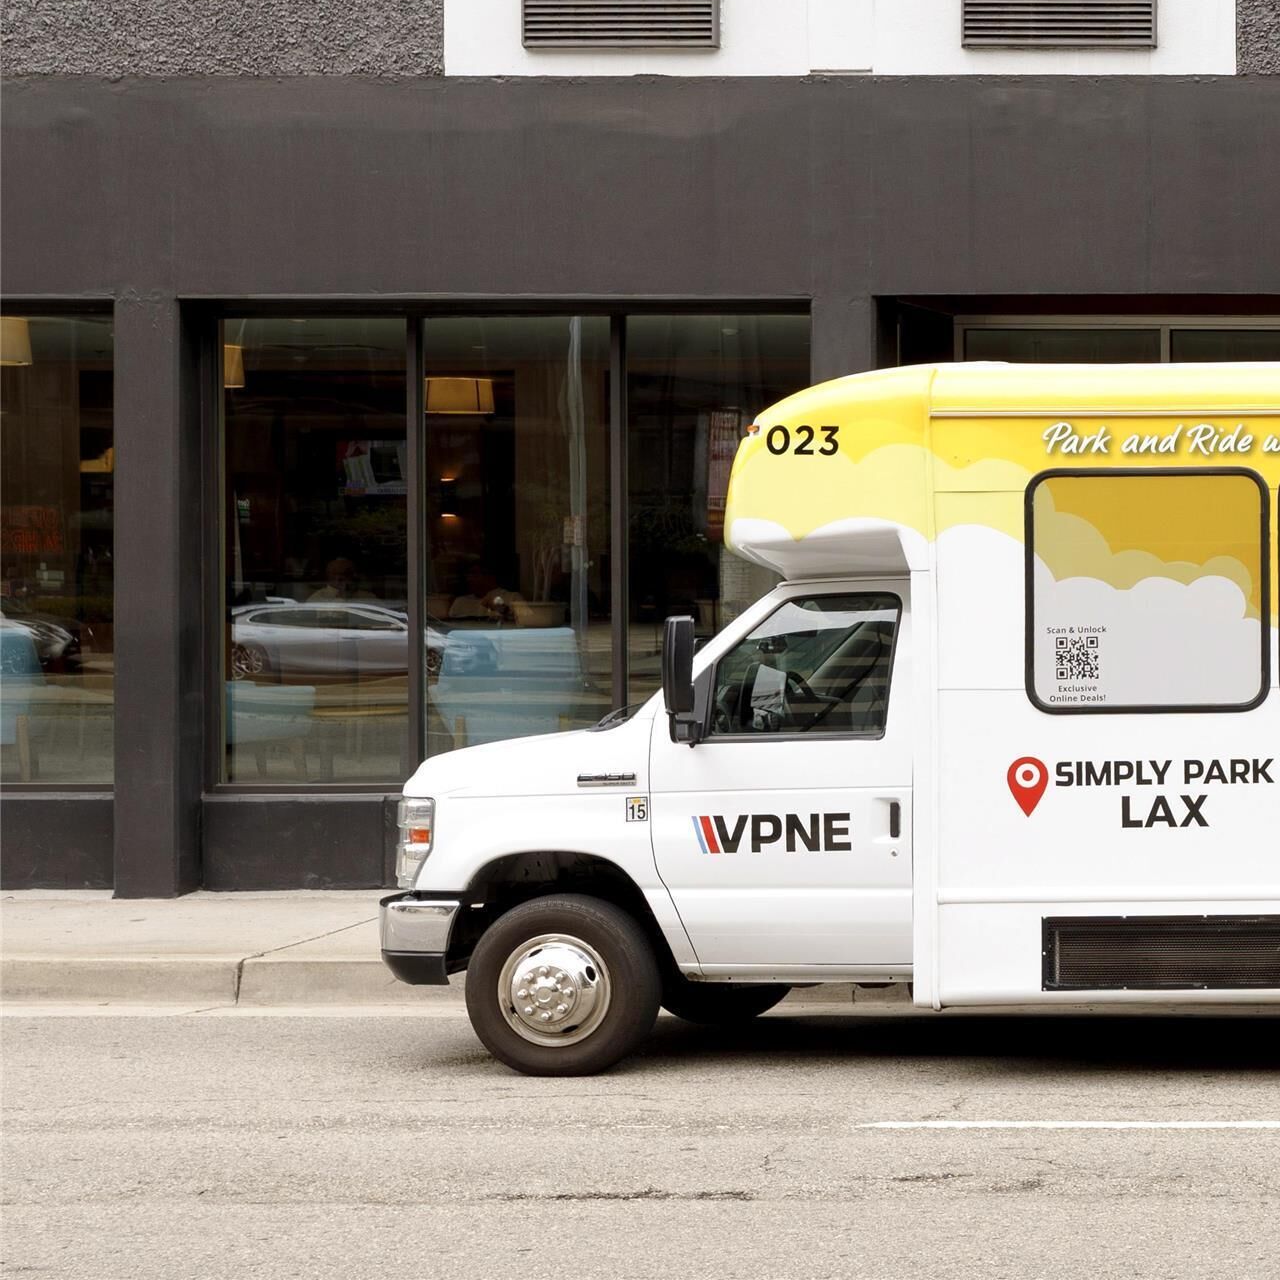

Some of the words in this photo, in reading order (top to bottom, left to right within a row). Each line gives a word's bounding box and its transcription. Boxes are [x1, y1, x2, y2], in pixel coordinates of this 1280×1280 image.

[766, 424, 840, 456] 023
[1042, 422, 1111, 454] Park
[1120, 425, 1183, 453] and
[1186, 423, 1253, 455] Ride
[1046, 626, 1067, 635] Scan
[1068, 626, 1075, 634] &
[1077, 625, 1107, 634] Unlock
[1049, 694, 1078, 703] Online
[1080, 694, 1106, 702] Deals!
[1058, 684, 1098, 693] Exclusive
[1055, 759, 1173, 787] SIMPLY
[1183, 758, 1275, 785] PARK
[628, 803, 646, 820] 15
[1121, 794, 1210, 829] LAX
[712, 811, 853, 854] VPNE
